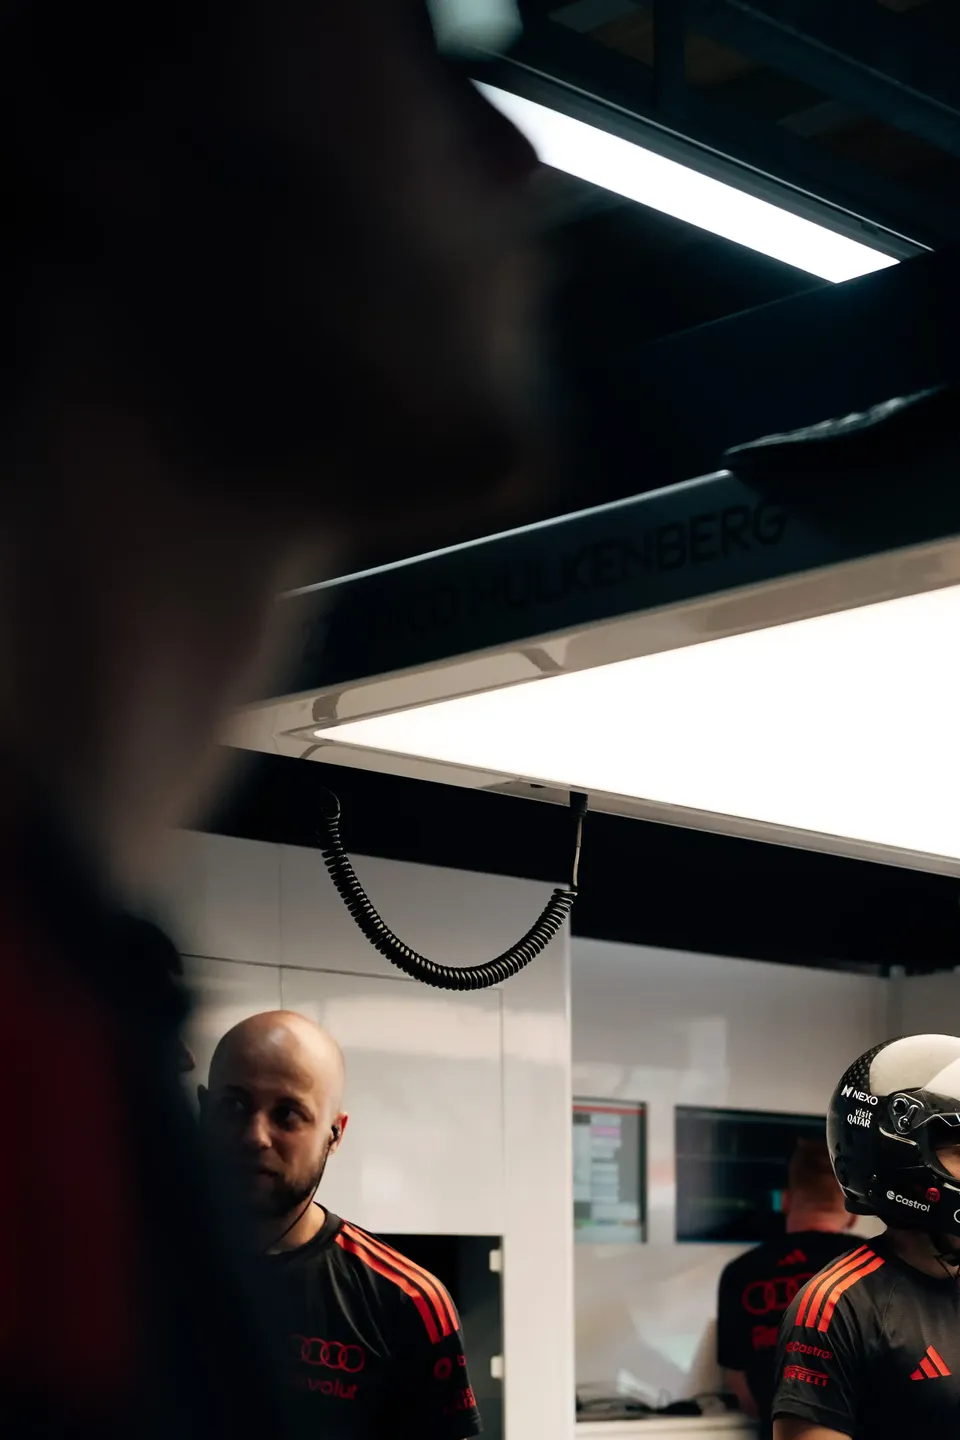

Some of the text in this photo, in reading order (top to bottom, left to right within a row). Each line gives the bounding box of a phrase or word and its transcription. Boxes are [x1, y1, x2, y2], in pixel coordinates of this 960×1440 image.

[852, 1090, 879, 1106] NEXO
[847, 1113, 871, 1129] QATAR
[855, 1108, 873, 1120] visit
[895, 1194, 931, 1213] Castrol
